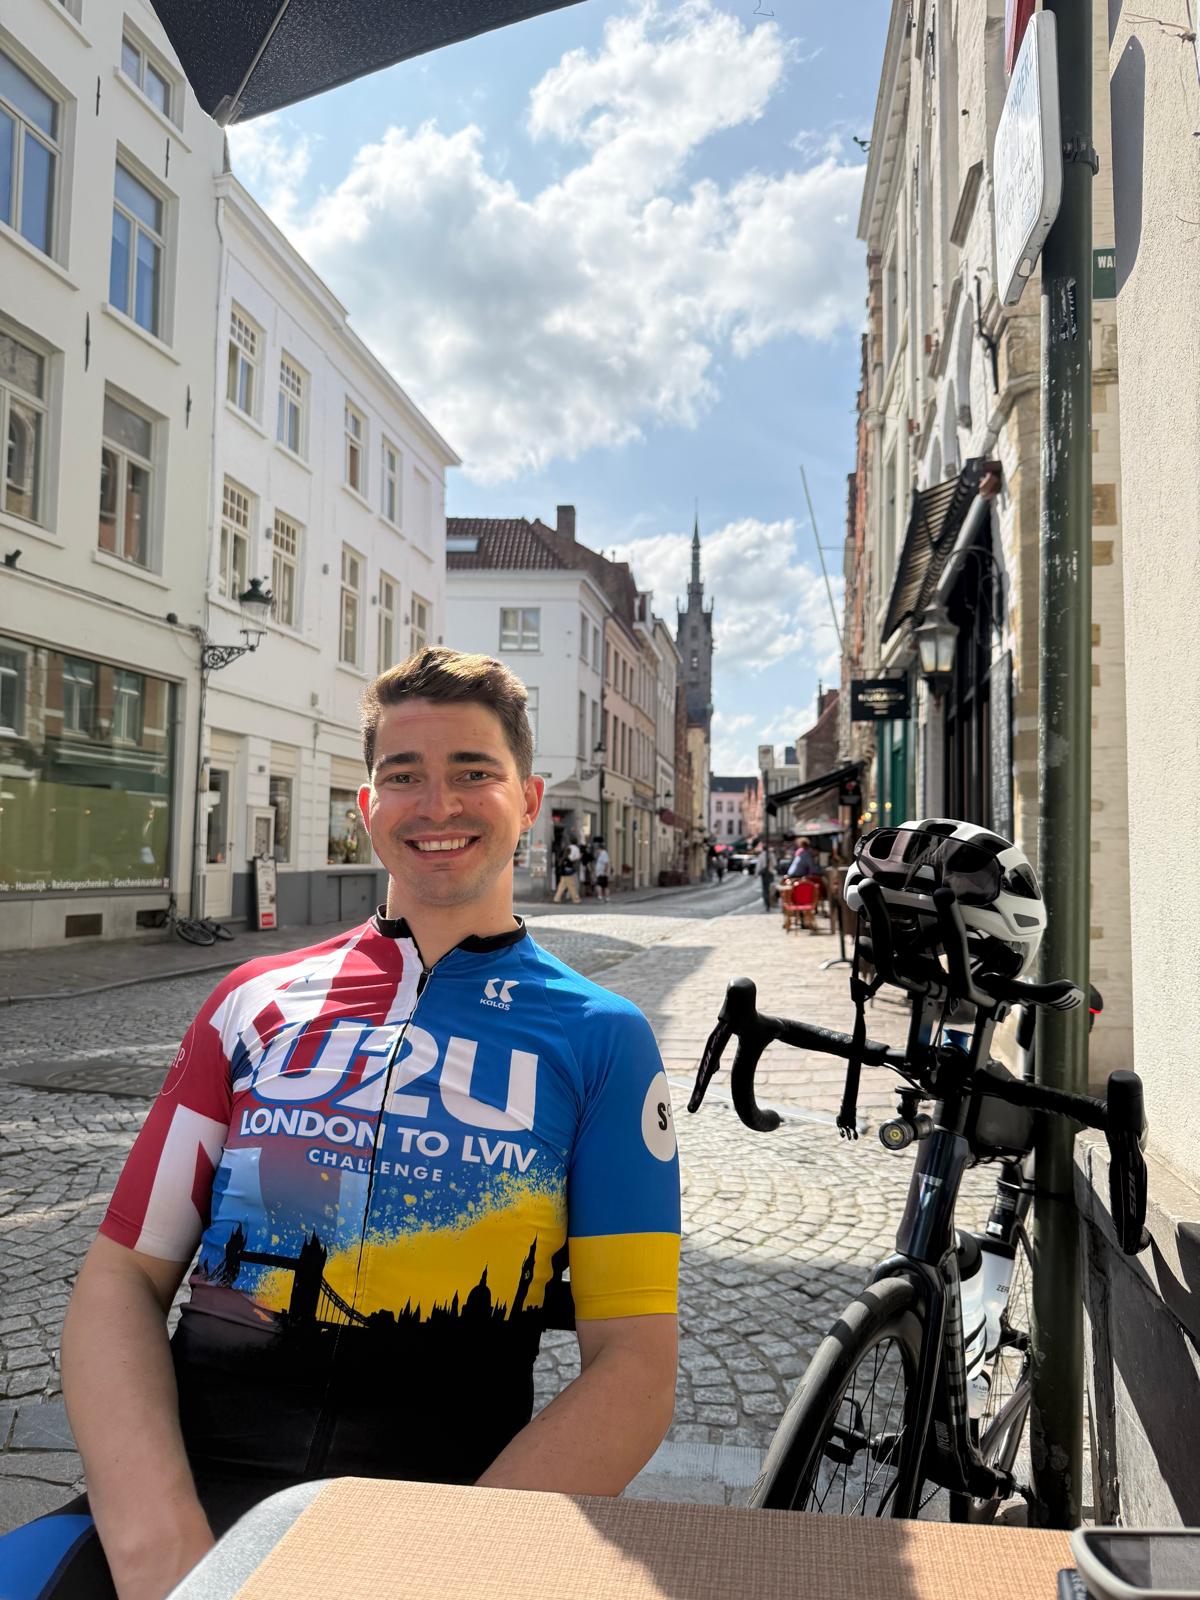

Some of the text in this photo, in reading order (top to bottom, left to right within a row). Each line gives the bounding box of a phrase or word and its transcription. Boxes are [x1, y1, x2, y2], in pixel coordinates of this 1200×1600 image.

[15, 880, 47, 892] Huwelijk
[253, 1020, 539, 1132] U2U
[239, 1107, 538, 1173] LONDON TO LVIV
[308, 1148, 443, 1182] CHALLENGE
